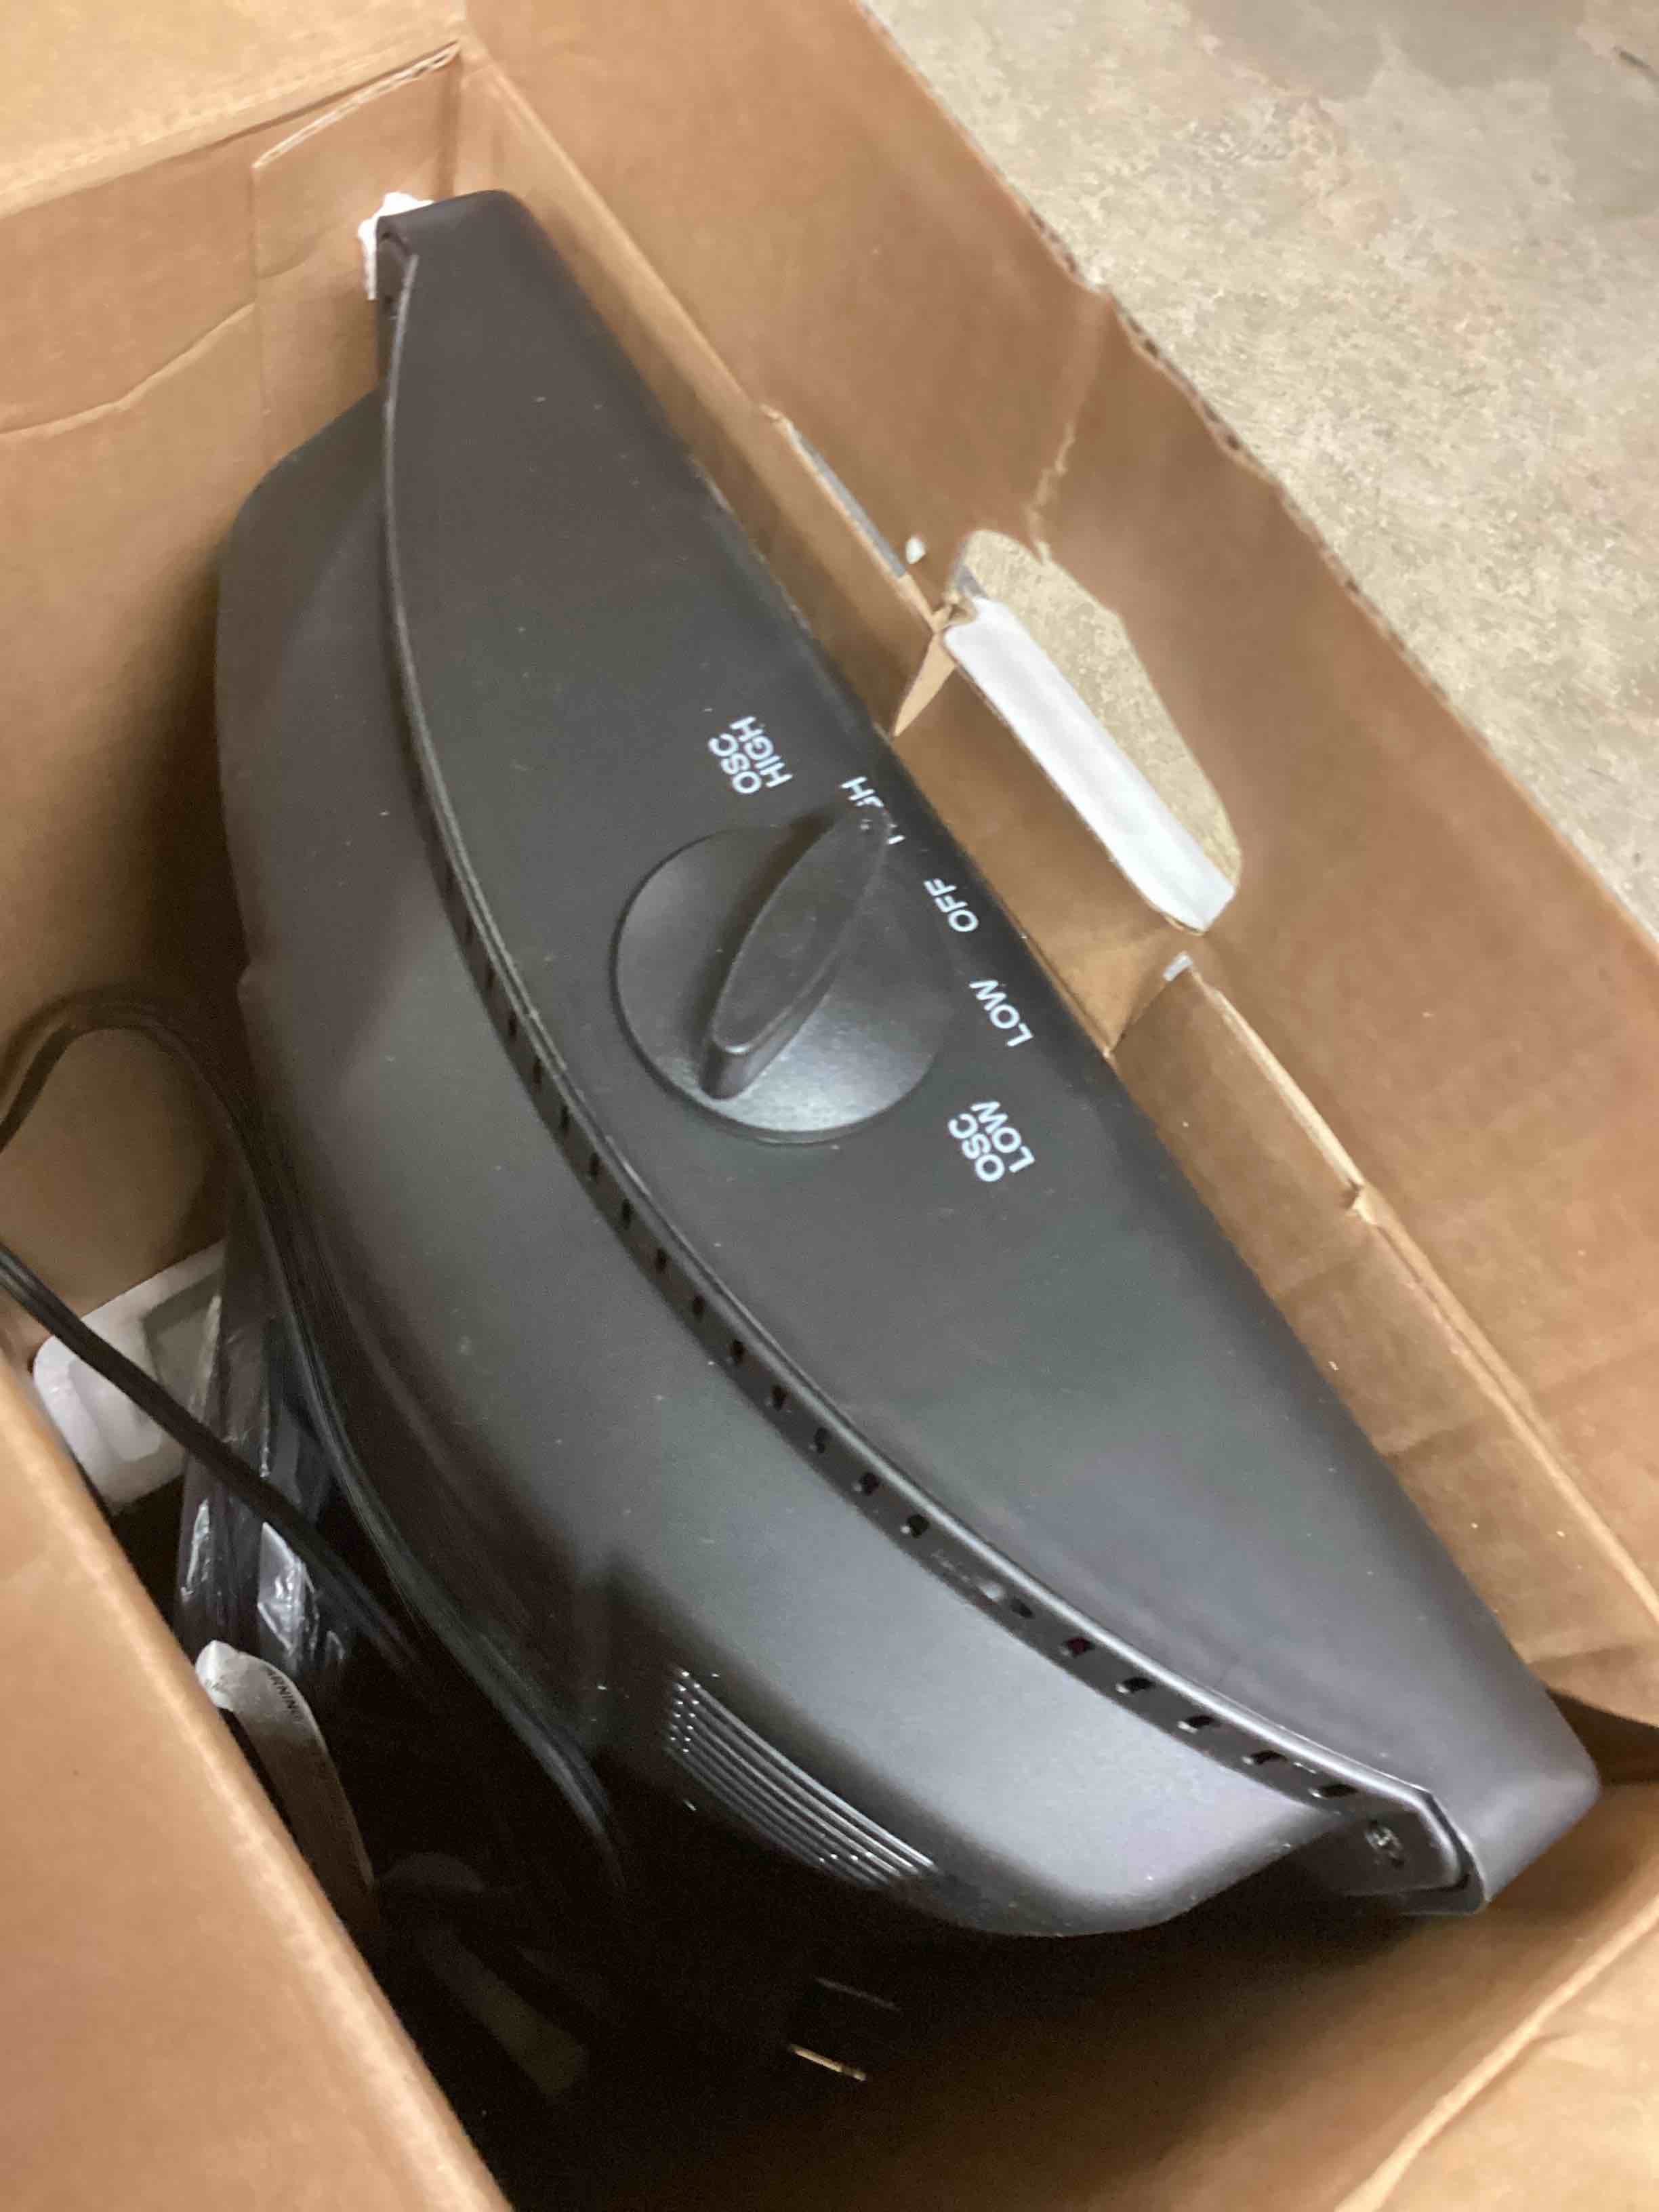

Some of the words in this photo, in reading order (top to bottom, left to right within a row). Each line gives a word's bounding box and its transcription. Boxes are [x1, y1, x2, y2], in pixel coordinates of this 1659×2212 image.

[708, 733, 762, 793] OSC
[729, 716, 793, 787] HIGH
[923, 879, 979, 932] OFF
[968, 980, 1033, 1046] LOW
[948, 1113, 1005, 1182] OSC
[970, 1101, 1035, 1173] LOW
